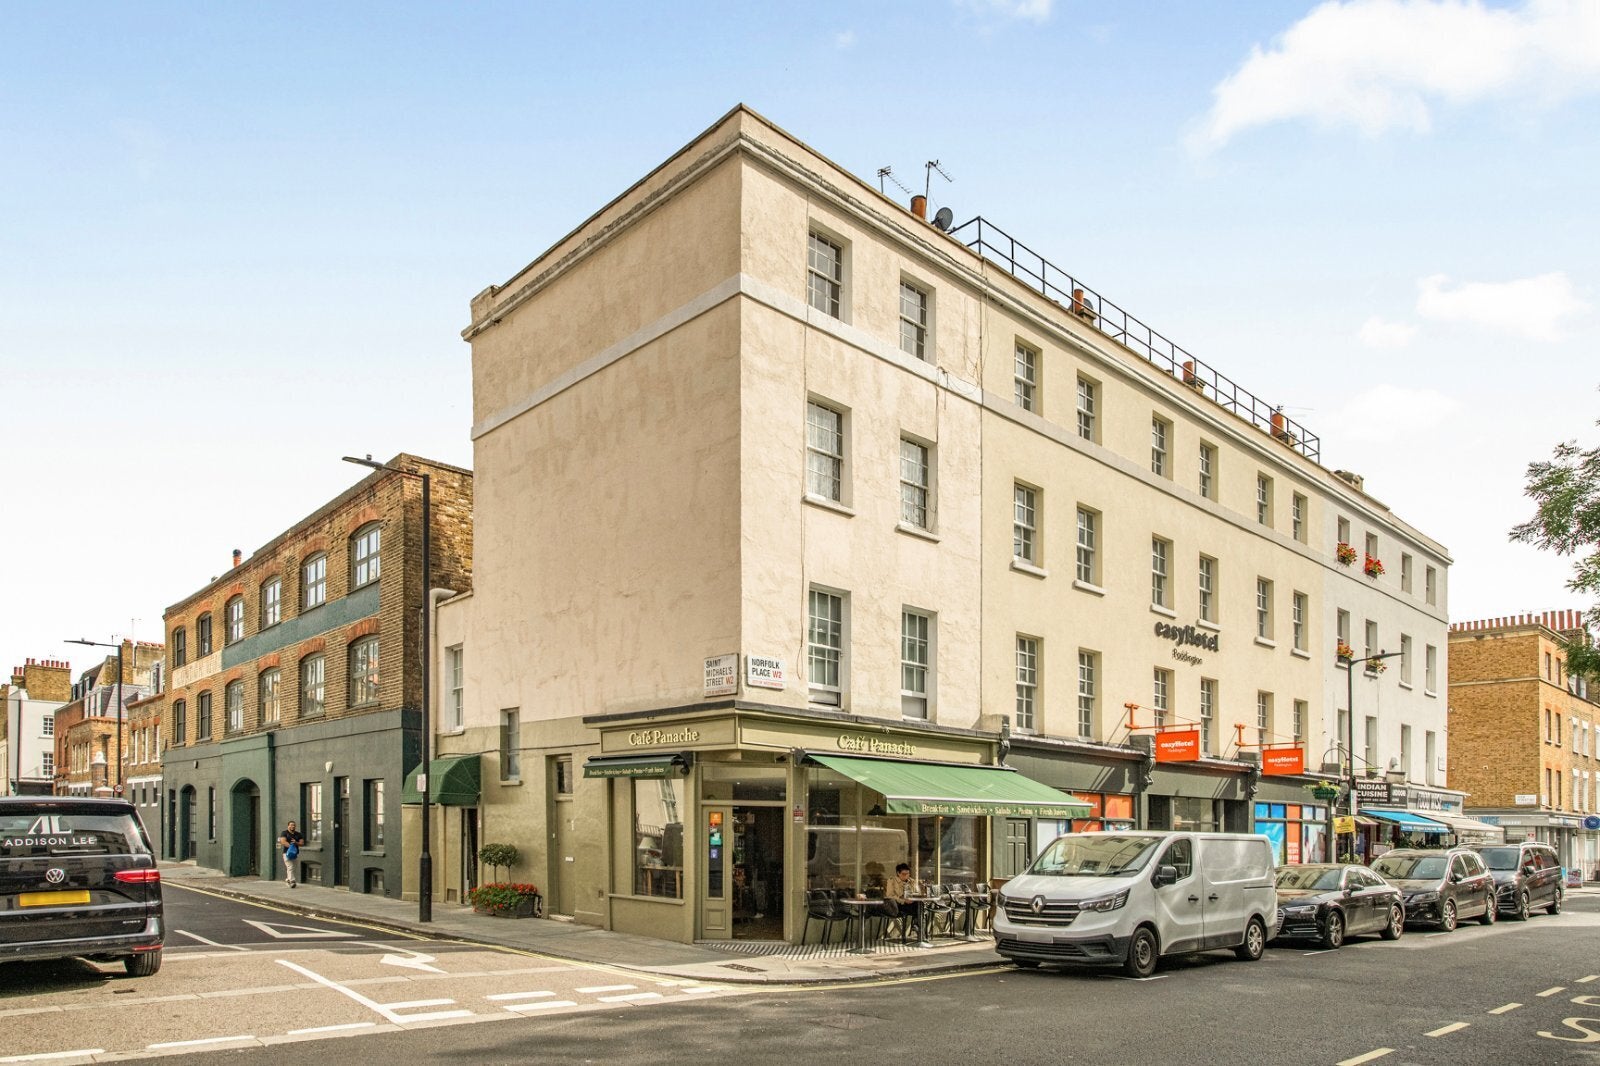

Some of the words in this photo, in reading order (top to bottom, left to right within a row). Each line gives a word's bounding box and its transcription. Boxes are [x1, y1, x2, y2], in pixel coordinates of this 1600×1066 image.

[1154, 621, 1219, 652] easyHotel
[1172, 648, 1203, 666] Paddington
[705, 658, 721, 669] SAINT
[751, 658, 780, 669] NORFOLK
[705, 666, 733, 678] MICHAEL'S
[751, 667, 771, 678] PLACE
[772, 670, 783, 679] W2
[705, 676, 724, 687] STREET
[725, 675, 735, 685] W2
[628, 730, 652, 746] Café
[653, 727, 699, 745] Panache
[838, 734, 865, 750] Café
[869, 737, 917, 755] Panache
[1160, 739, 1195, 750] easyHotel
[1267, 755, 1299, 765] easyHotel
[1357, 783, 1387, 791] INDIAN
[1357, 790, 1388, 798] CUISINE
[4, 836, 67, 847] ADDISON
[72, 836, 97, 845] LEE
